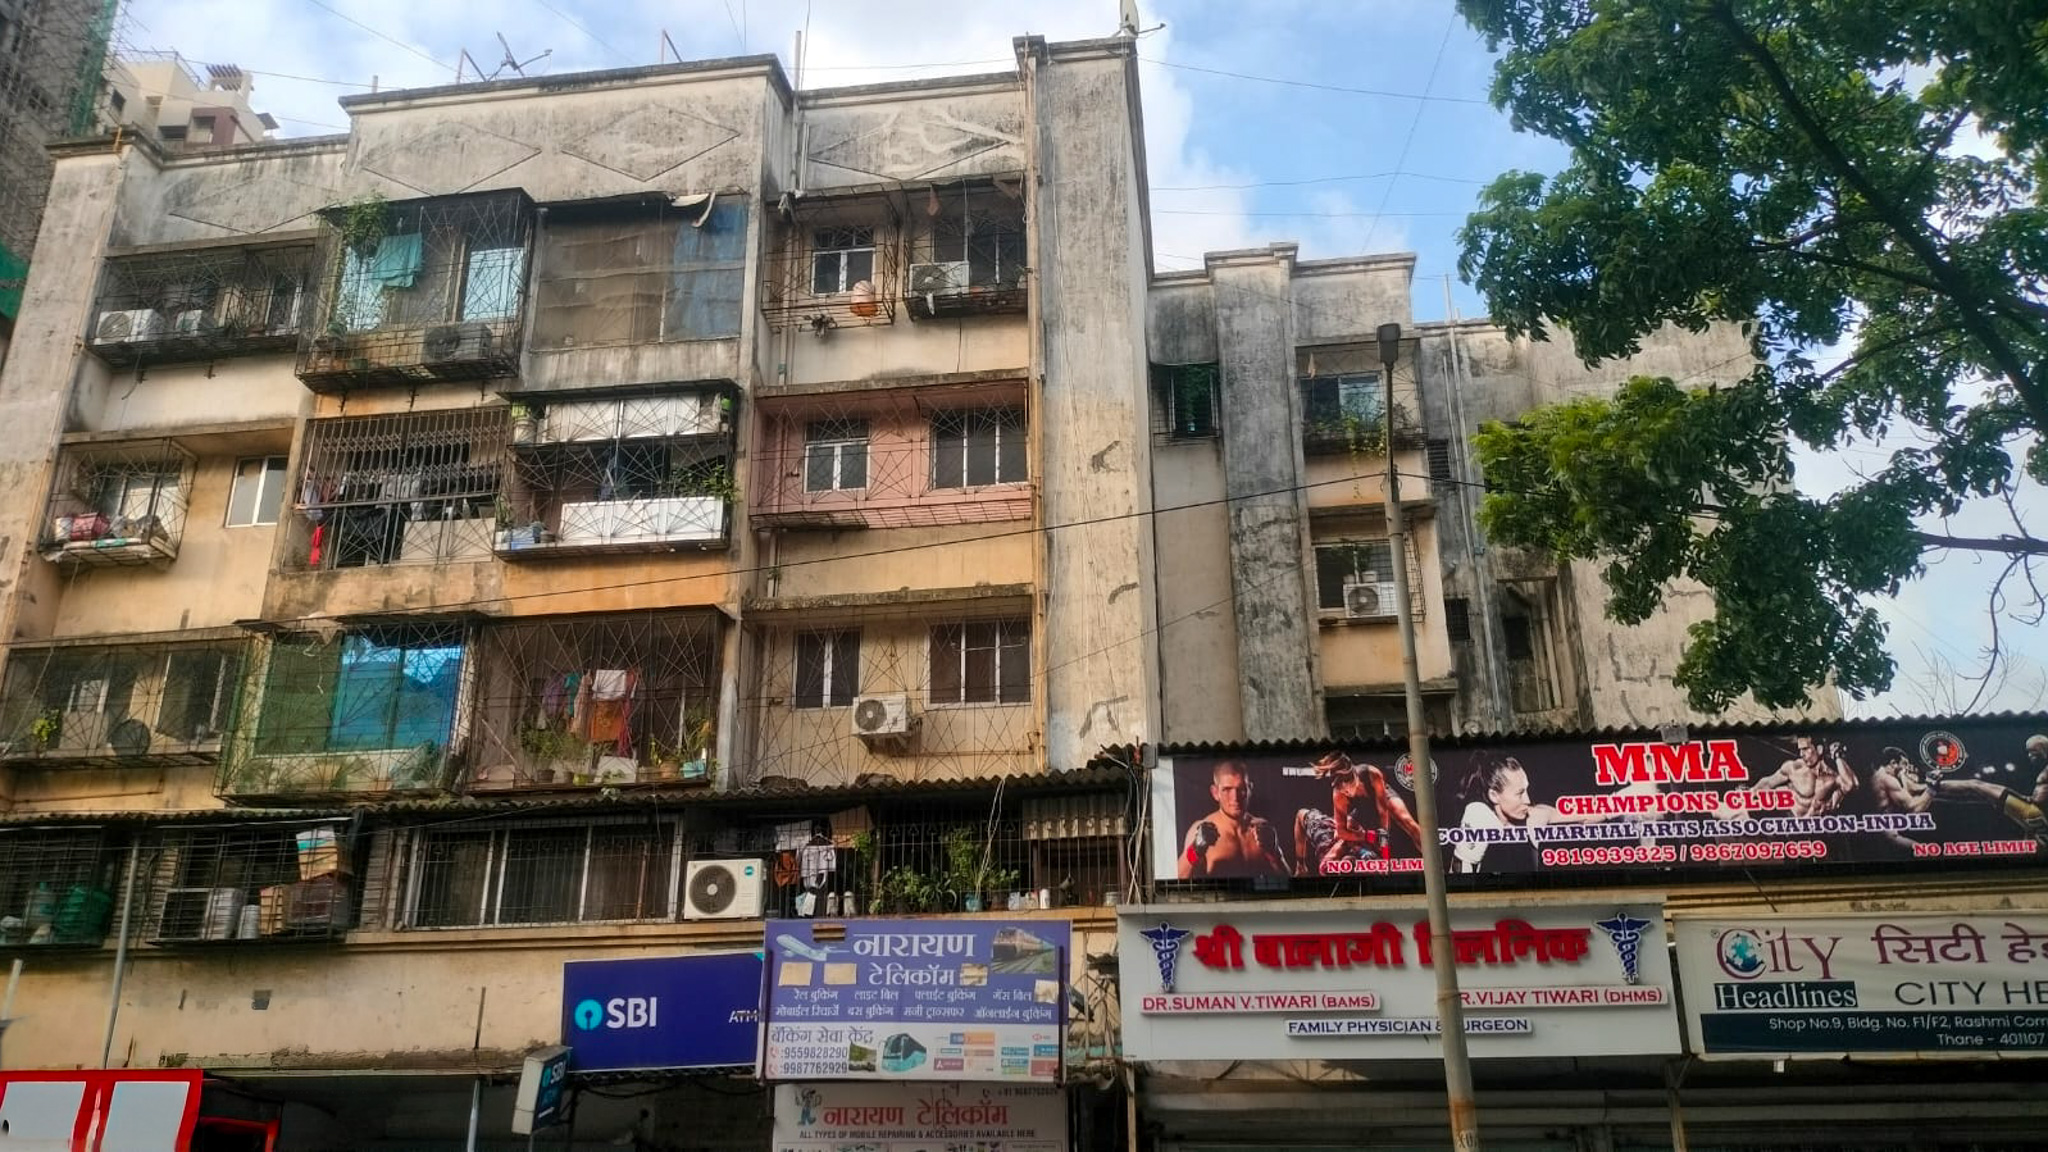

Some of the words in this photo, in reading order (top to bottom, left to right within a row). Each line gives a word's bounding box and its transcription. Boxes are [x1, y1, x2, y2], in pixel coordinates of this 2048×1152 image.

[1592, 740, 1749, 785] MMA
[1557, 790, 1719, 815] CHAMPIONS
[1725, 790, 1796, 810] CLUB
[1438, 826, 1530, 844] COMBAT
[1534, 823, 1638, 842] MARTIAL
[1642, 819, 1699, 838] ARTS
[1703, 814, 1936, 837] ASSOCIATION-INDIA
[1541, 846, 1676, 866] 9819939325
[1690, 841, 1826, 861] 9867097659
[1913, 842, 1941, 857] NO
[1944, 842, 1981, 855] AGE
[1983, 840, 2037, 854] LIMIT
[1327, 860, 1352, 874] NO
[1355, 859, 1388, 873] AGE
[1390, 858, 1424, 872] LIM
[853, 933, 977, 957] नारायण
[1192, 924, 1243, 968] श्री
[1870, 923, 1988, 964] सिटी
[867, 961, 956, 986] टेलिकॉम
[1143, 997, 1236, 1010] DR.SUMAN
[1240, 995, 1317, 1009] V.TIWARI
[1321, 994, 1375, 1009] (BAMS)
[1531, 989, 1599, 1004] TIWARI
[1603, 988, 1663, 1004] (DHMS)
[1717, 982, 1857, 1008] Headlines
[1895, 981, 1986, 1005] CITY
[606, 996, 658, 1029] SBI
[728, 1009, 759, 1023] ATM
[1769, 1018, 1806, 1032] Shop
[1809, 1017, 1844, 1030] No.9,
[1848, 1016, 1883, 1032] Bldg.
[1887, 1017, 1910, 1028] No.
[1955, 1015, 2010, 1028] Rashmi
[1288, 1021, 1343, 1033] FAMILY
[1347, 1020, 1432, 1032] PHYSICIAN
[1936, 1034, 1984, 1046] Thane
[2000, 1032, 2045, 1045] 401107
[823, 1107, 904, 1127] नारायण
[916, 1099, 1009, 1127] टेलिकॉम
